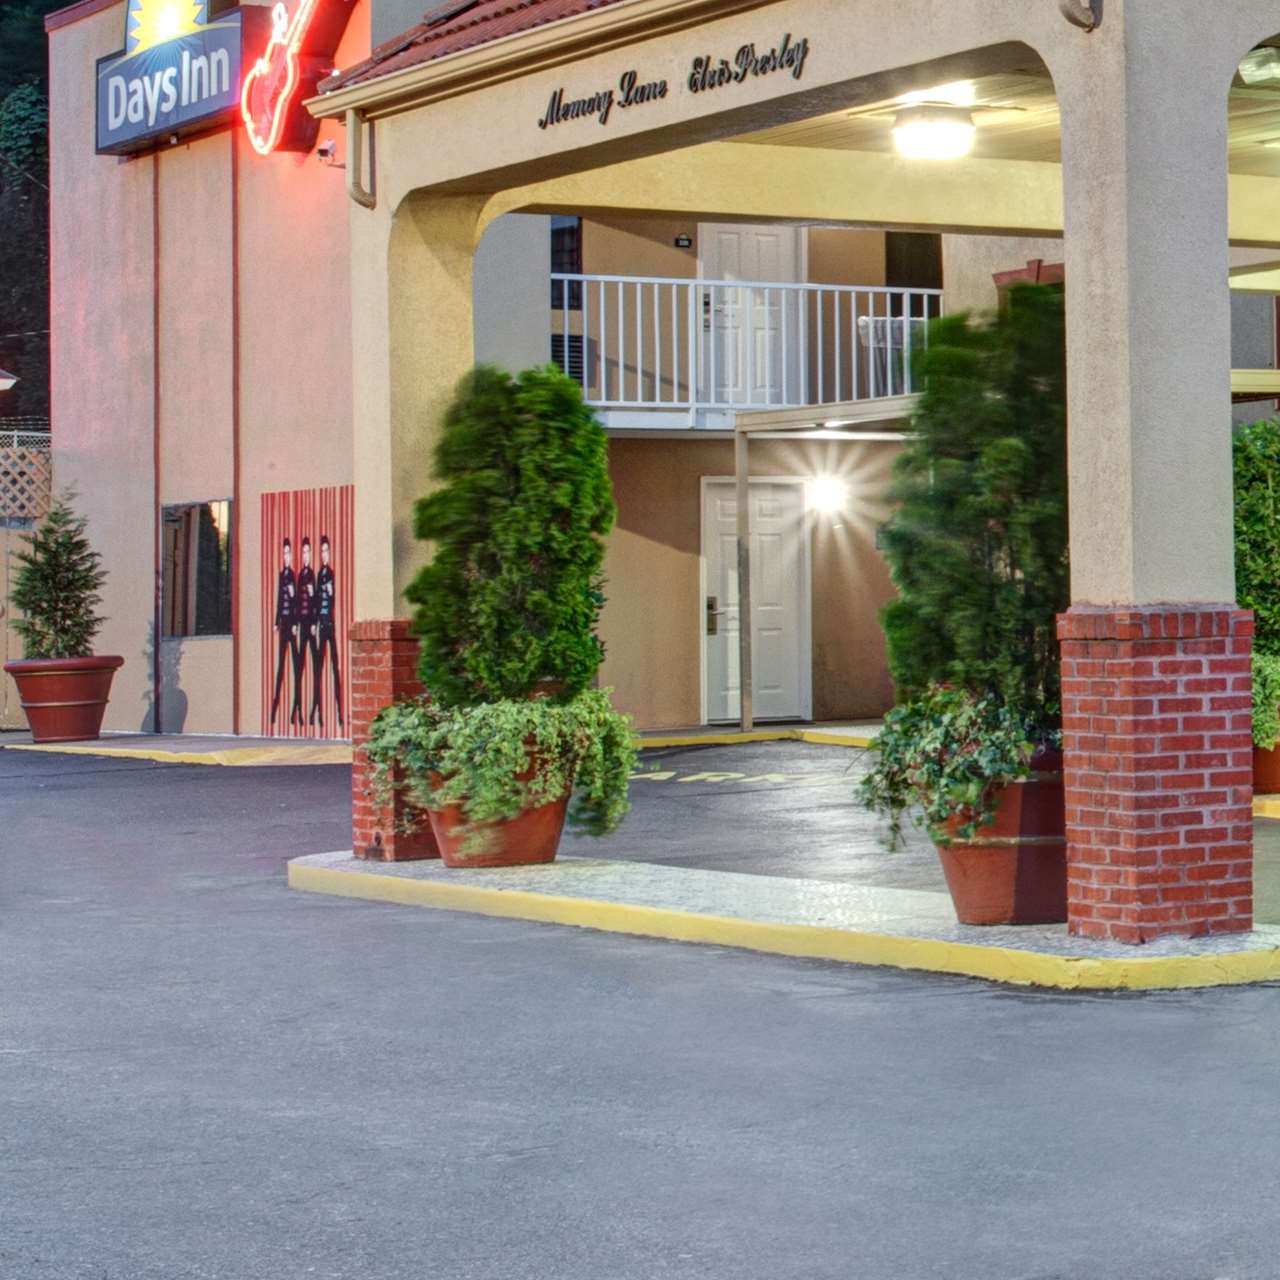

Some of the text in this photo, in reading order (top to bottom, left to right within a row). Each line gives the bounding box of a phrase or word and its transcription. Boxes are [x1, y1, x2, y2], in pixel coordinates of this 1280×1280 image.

[108, 47, 230, 131] Days Inn
[537, 33, 810, 130] Memory Lane Elvis Presley
